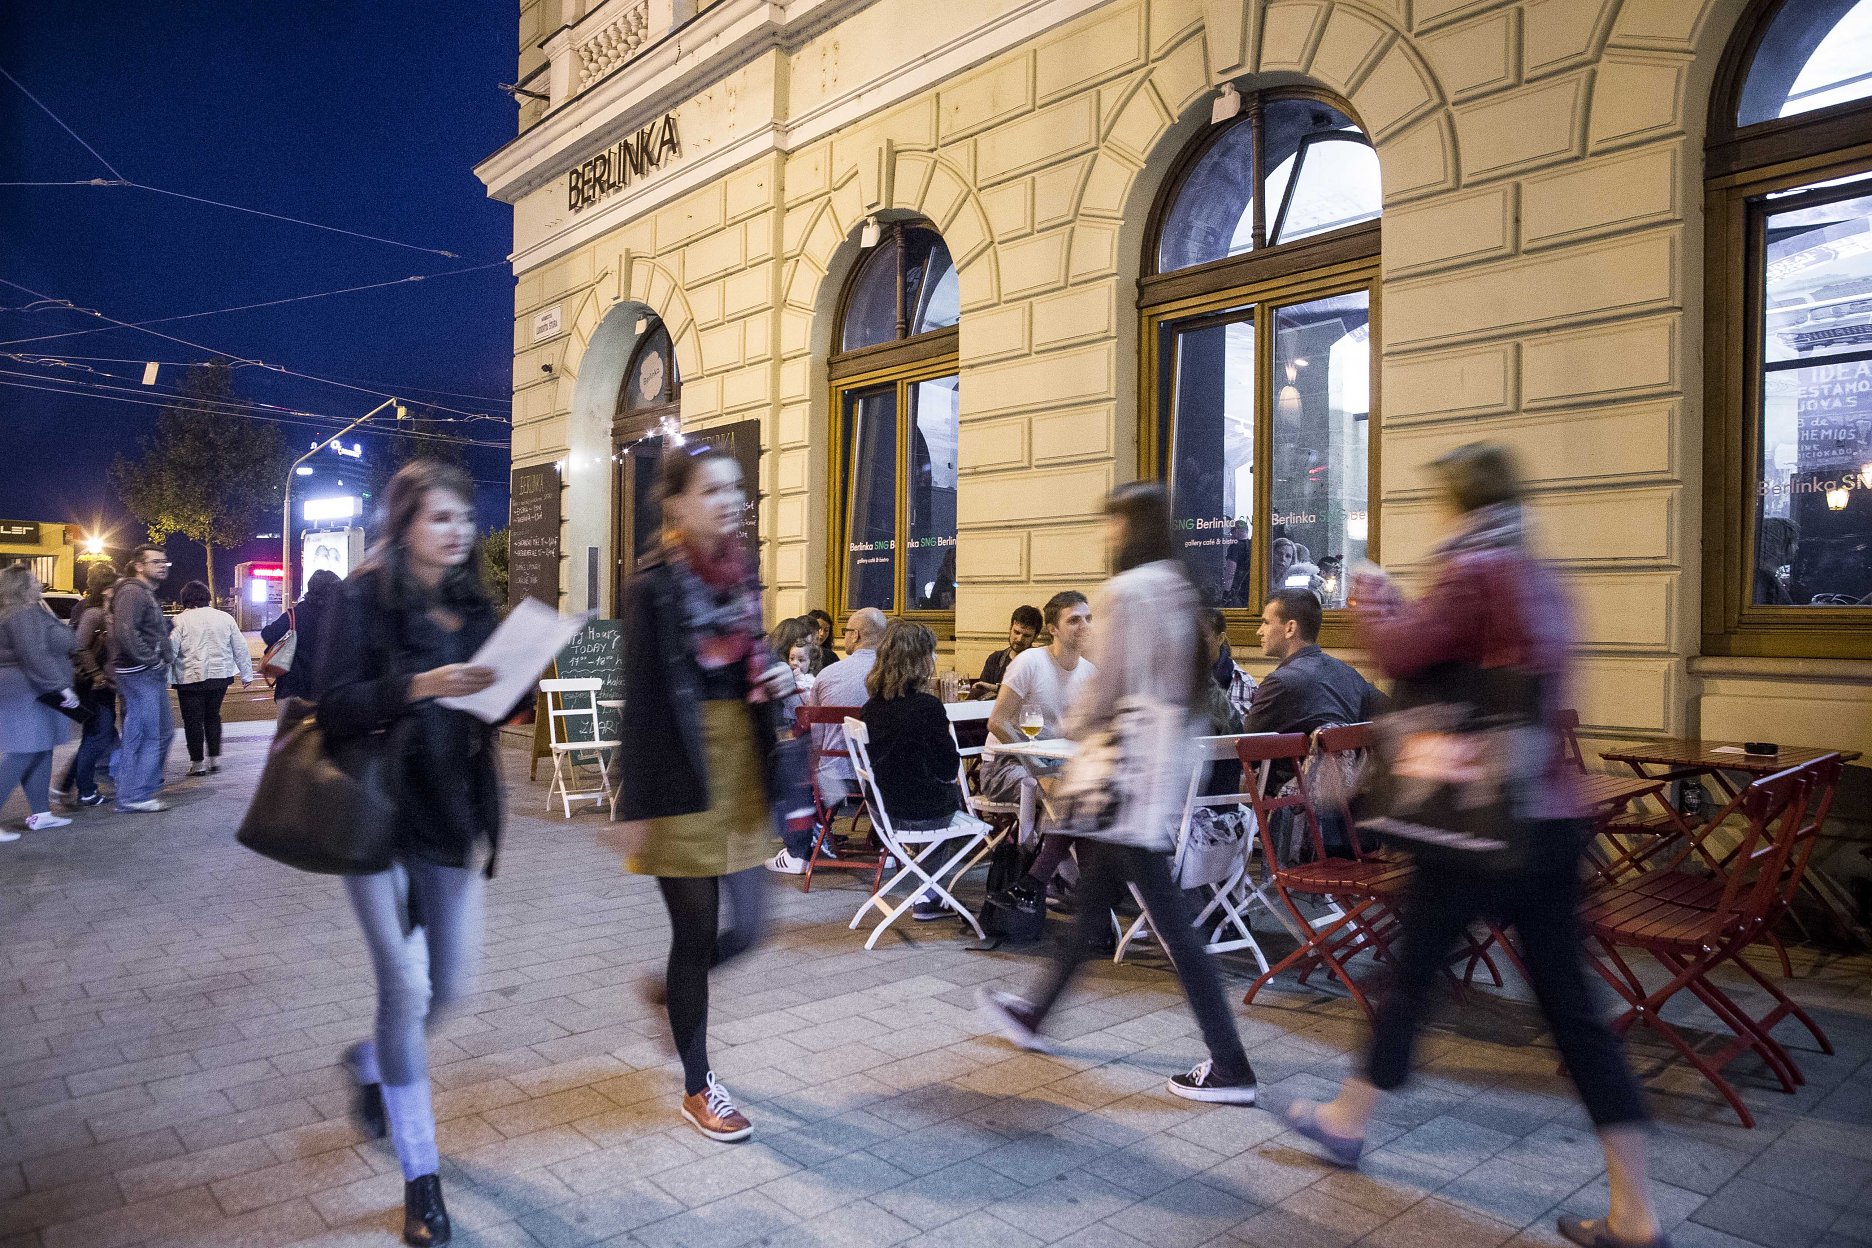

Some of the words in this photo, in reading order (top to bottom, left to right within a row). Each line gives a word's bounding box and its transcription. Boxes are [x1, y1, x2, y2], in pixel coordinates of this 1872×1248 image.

[569, 113, 677, 211] BERLINKA
[1811, 360, 1871, 382] IDEA
[1798, 380, 1872, 398] ESTAMO
[1800, 429, 1856, 440] HEMIOS
[1759, 477, 1837, 496] Berlinka
[1842, 473, 1872, 491] SN
[1196, 517, 1236, 529] Berlinka
[1239, 516, 1253, 528] SN
[1271, 511, 1316, 526] Berlinka
[849, 541, 874, 552] Berlinka
[874, 541, 889, 550] SNG
[920, 538, 937, 547] SNG
[937, 536, 956, 546] Berlin
[1184, 540, 1202, 548] gallery
[571, 643, 607, 654] TODAY
